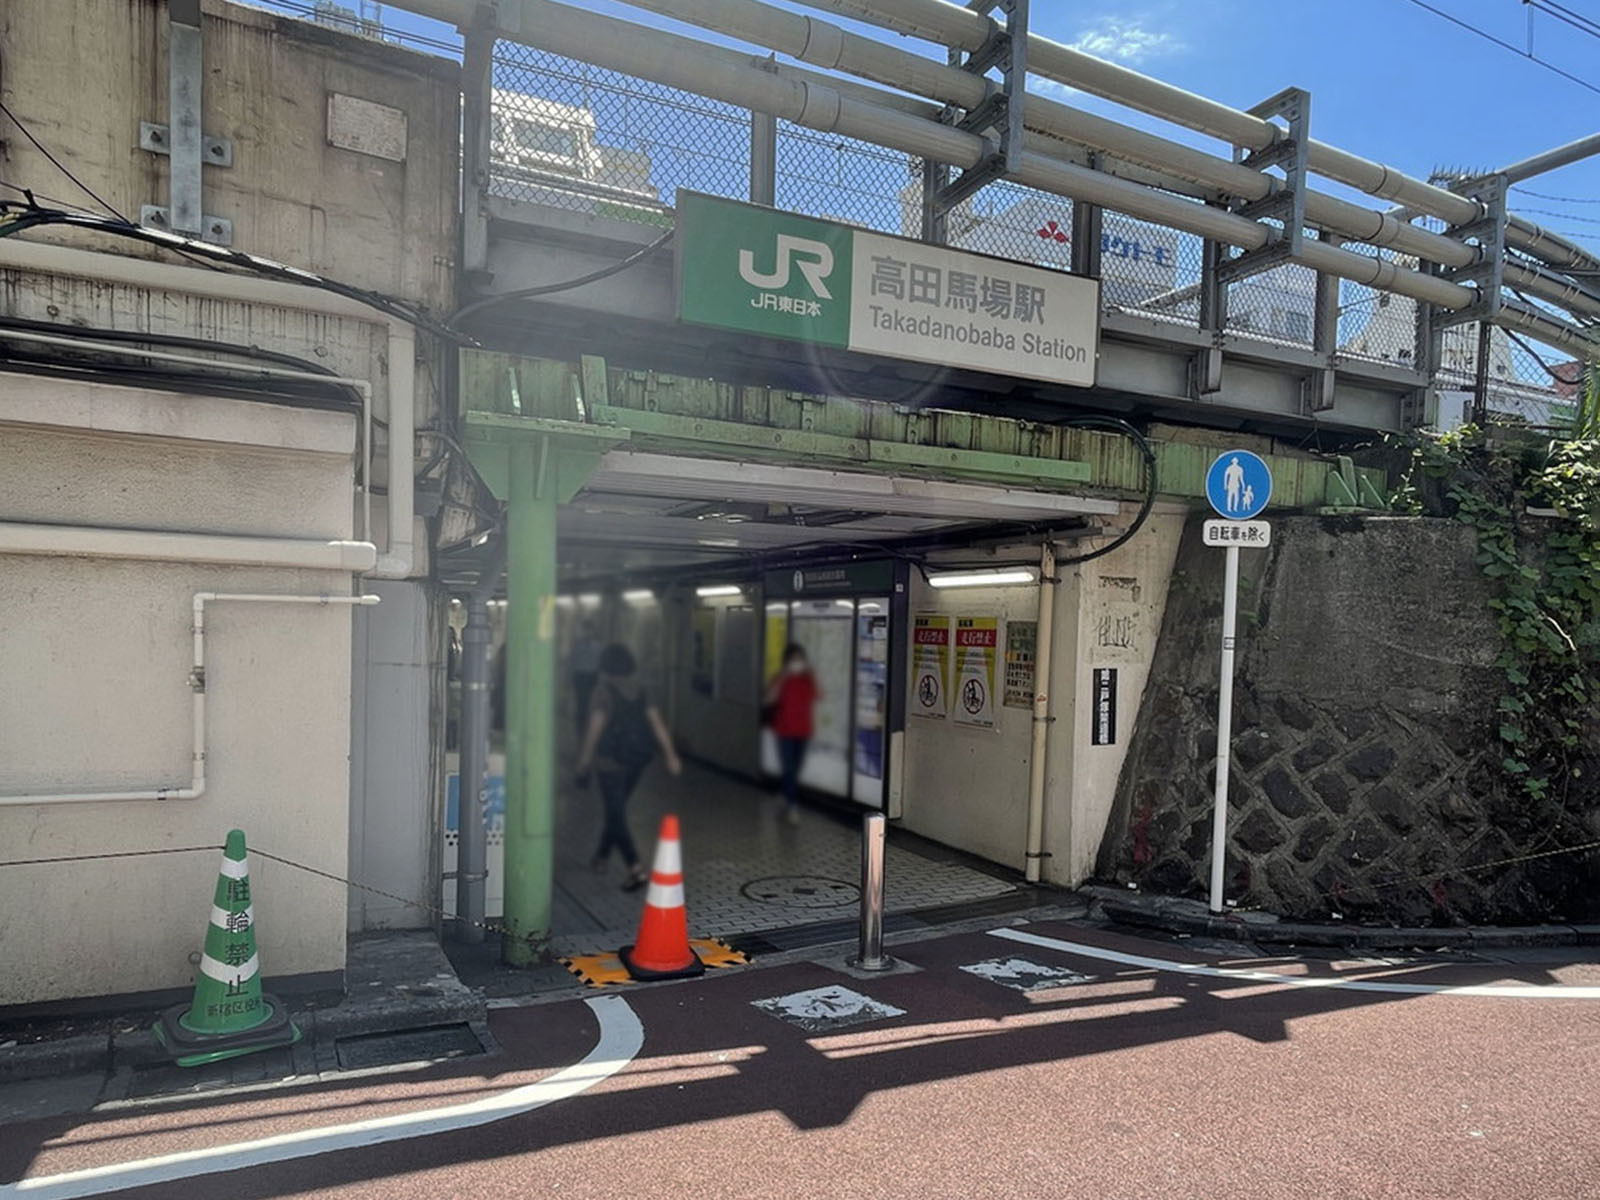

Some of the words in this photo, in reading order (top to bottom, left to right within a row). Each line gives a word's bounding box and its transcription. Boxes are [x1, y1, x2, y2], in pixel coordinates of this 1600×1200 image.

[739, 233, 834, 300] JR
[870, 256, 1046, 325] 高田馬場駅
[751, 292, 822, 317] JR東日本
[869, 305, 1016, 350] Takadanobaba
[1021, 332, 1087, 364] Station
[1209, 525, 1265, 542] 自転車を除く
[226, 880, 250, 997] 駐輪禁止
